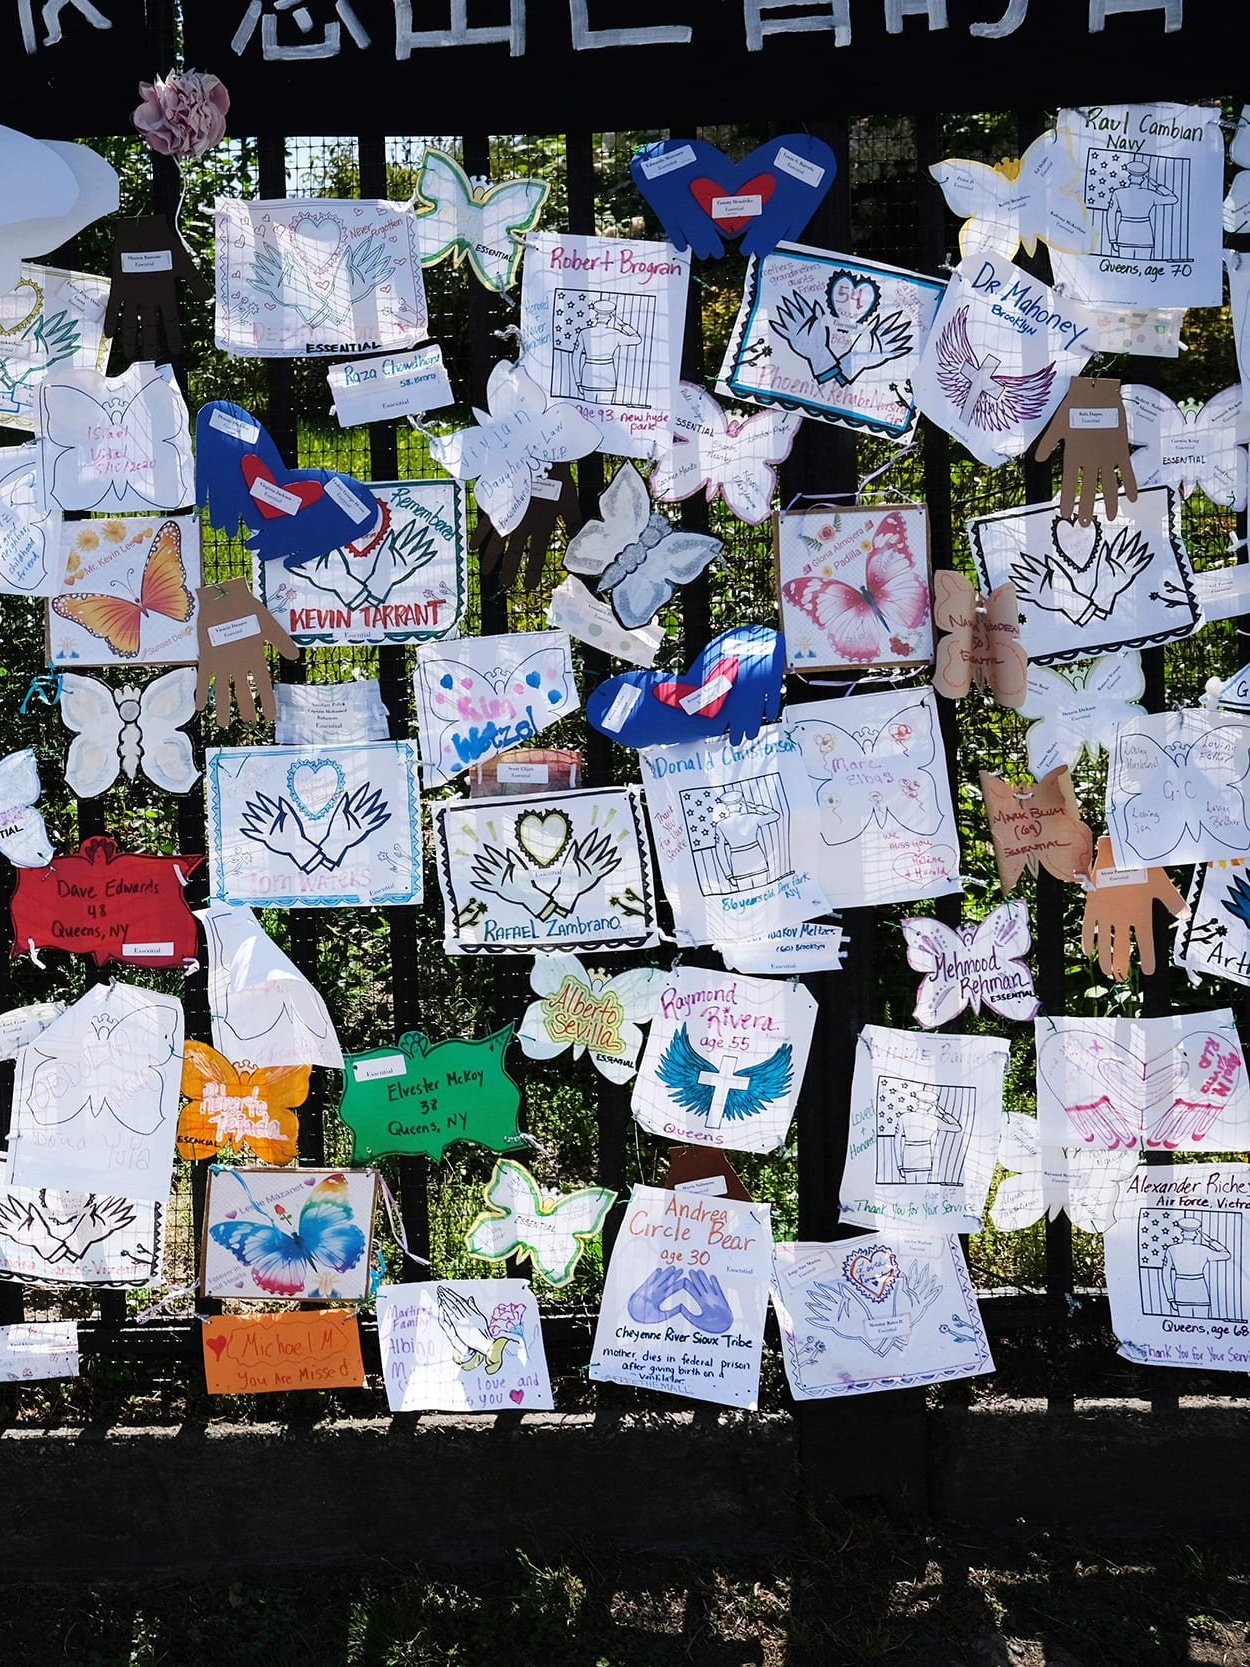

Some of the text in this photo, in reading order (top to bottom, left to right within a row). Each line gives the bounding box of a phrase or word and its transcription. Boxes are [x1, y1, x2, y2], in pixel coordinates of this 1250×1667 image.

[1084, 107, 1203, 143] Raul Cambian
[1107, 134, 1146, 152] Navy
[474, 244, 514, 263] ESSENTIAL
[550, 247, 682, 285] Robert Brogran
[1099, 259, 1193, 283] Queens, age 70
[836, 286, 863, 309] 54
[1005, 281, 1088, 351] Mahoney
[305, 341, 382, 354] ESSENTIAL
[344, 365, 377, 385] Raza
[756, 364, 826, 401] Phoenix
[598, 408, 669, 424] 93 new hyde
[630, 422, 655, 435] park
[1162, 455, 1206, 465] ESSENTIAL
[391, 487, 458, 542] Remembered
[98, 545, 127, 566] Kevin
[122, 541, 136, 554] Lee
[811, 549, 834, 568] Gloria
[833, 548, 862, 571] Padilla
[289, 608, 353, 632] KEVIN
[359, 598, 447, 629] TARRANT
[656, 752, 715, 779] Donald
[832, 757, 882, 773] Marc
[993, 807, 1066, 825] MARK BLUM
[57, 876, 159, 899] Dave Edwards
[88, 904, 107, 919] 48
[722, 897, 738, 911] 86
[52, 920, 129, 943] Queens, NY
[484, 920, 540, 942] RAFAEL
[932, 946, 1001, 982] Mehmood
[960, 972, 1030, 1001] Rehman
[989, 991, 1036, 1003] ESSENTIAL
[548, 983, 617, 1026] Alberto
[660, 983, 738, 1020] Raymond
[550, 1014, 622, 1049] Sevilla
[699, 1035, 751, 1050] age 55
[595, 1053, 635, 1069] ESSENTIAL
[388, 1077, 439, 1102] Elvester
[420, 1099, 438, 1115] 38
[388, 1112, 469, 1138] Queens, NY
[662, 1122, 725, 1145] Queens
[1126, 1175, 1201, 1194] Alexander
[665, 1193, 728, 1224] Andrea
[854, 1200, 887, 1215] Thank
[908, 1202, 919, 1217] for
[942, 1200, 975, 1215] Service
[1156, 1196, 1174, 1206] Air
[629, 1210, 756, 1251] Circle Bear
[660, 1249, 711, 1265] age 30
[665, 1327, 690, 1343] River
[692, 1331, 719, 1346] Sioux
[720, 1335, 753, 1349] Tribe
[1162, 1319, 1249, 1339] Queens, age 68
[241, 1331, 312, 1358] Michael
[622, 1362, 715, 1377] after giving birth on
[642, 1350, 662, 1362] dies
[666, 1354, 676, 1362] in
[681, 1354, 714, 1368] federal
[721, 1358, 751, 1372] prison
[518, 1372, 539, 1387] and
[479, 1392, 503, 1406] you
